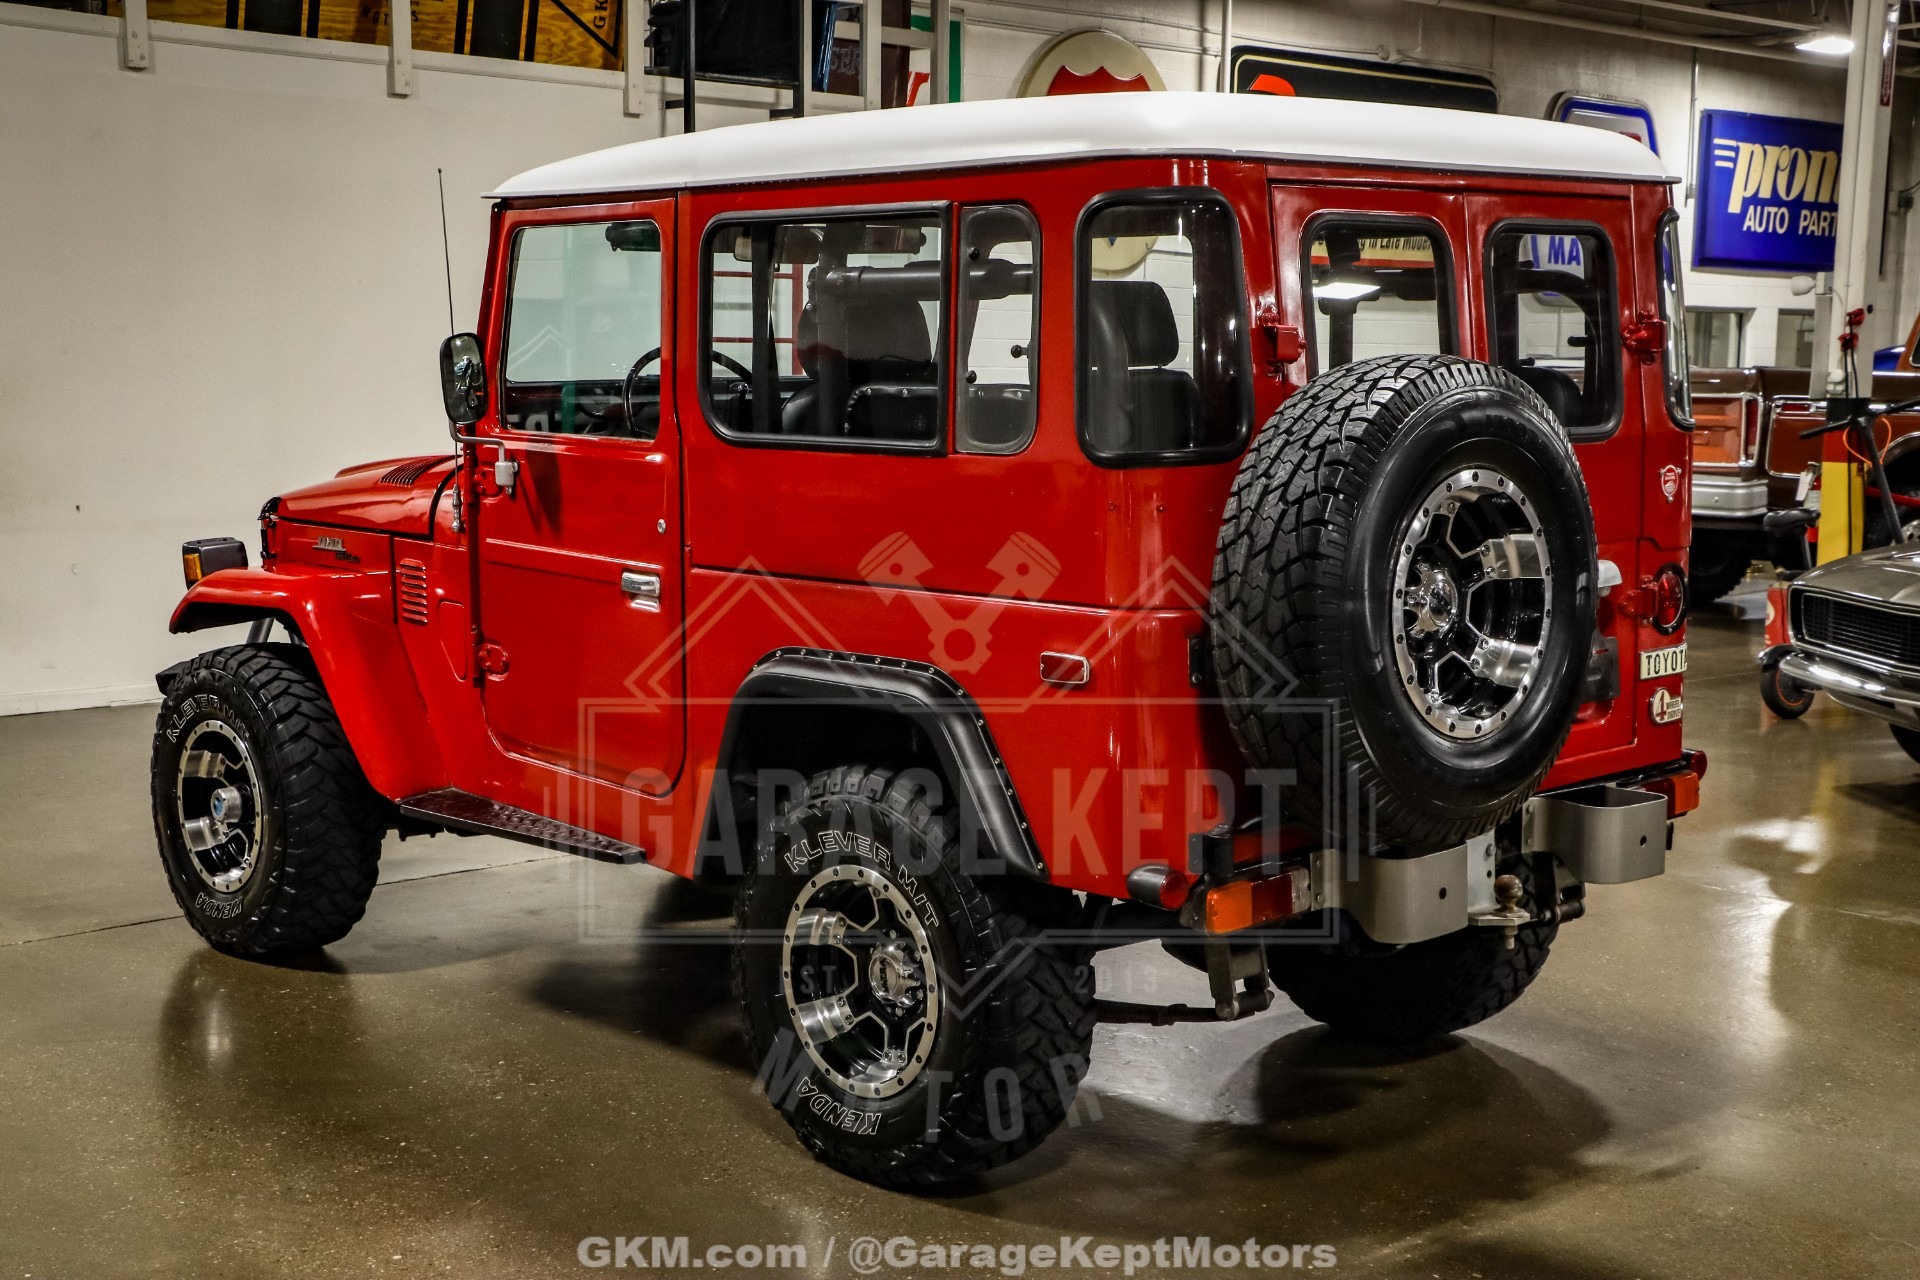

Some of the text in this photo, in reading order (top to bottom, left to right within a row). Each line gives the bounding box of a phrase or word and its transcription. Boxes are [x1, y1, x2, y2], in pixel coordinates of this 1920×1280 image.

[1728, 142, 1842, 214] pron
[1742, 205, 1789, 234] AUTO
[1646, 648, 1687, 676] TOYOT
[784, 830, 891, 872] KLEVER
[195, 892, 243, 919] KENDA
[796, 1076, 881, 1135] KENDA
